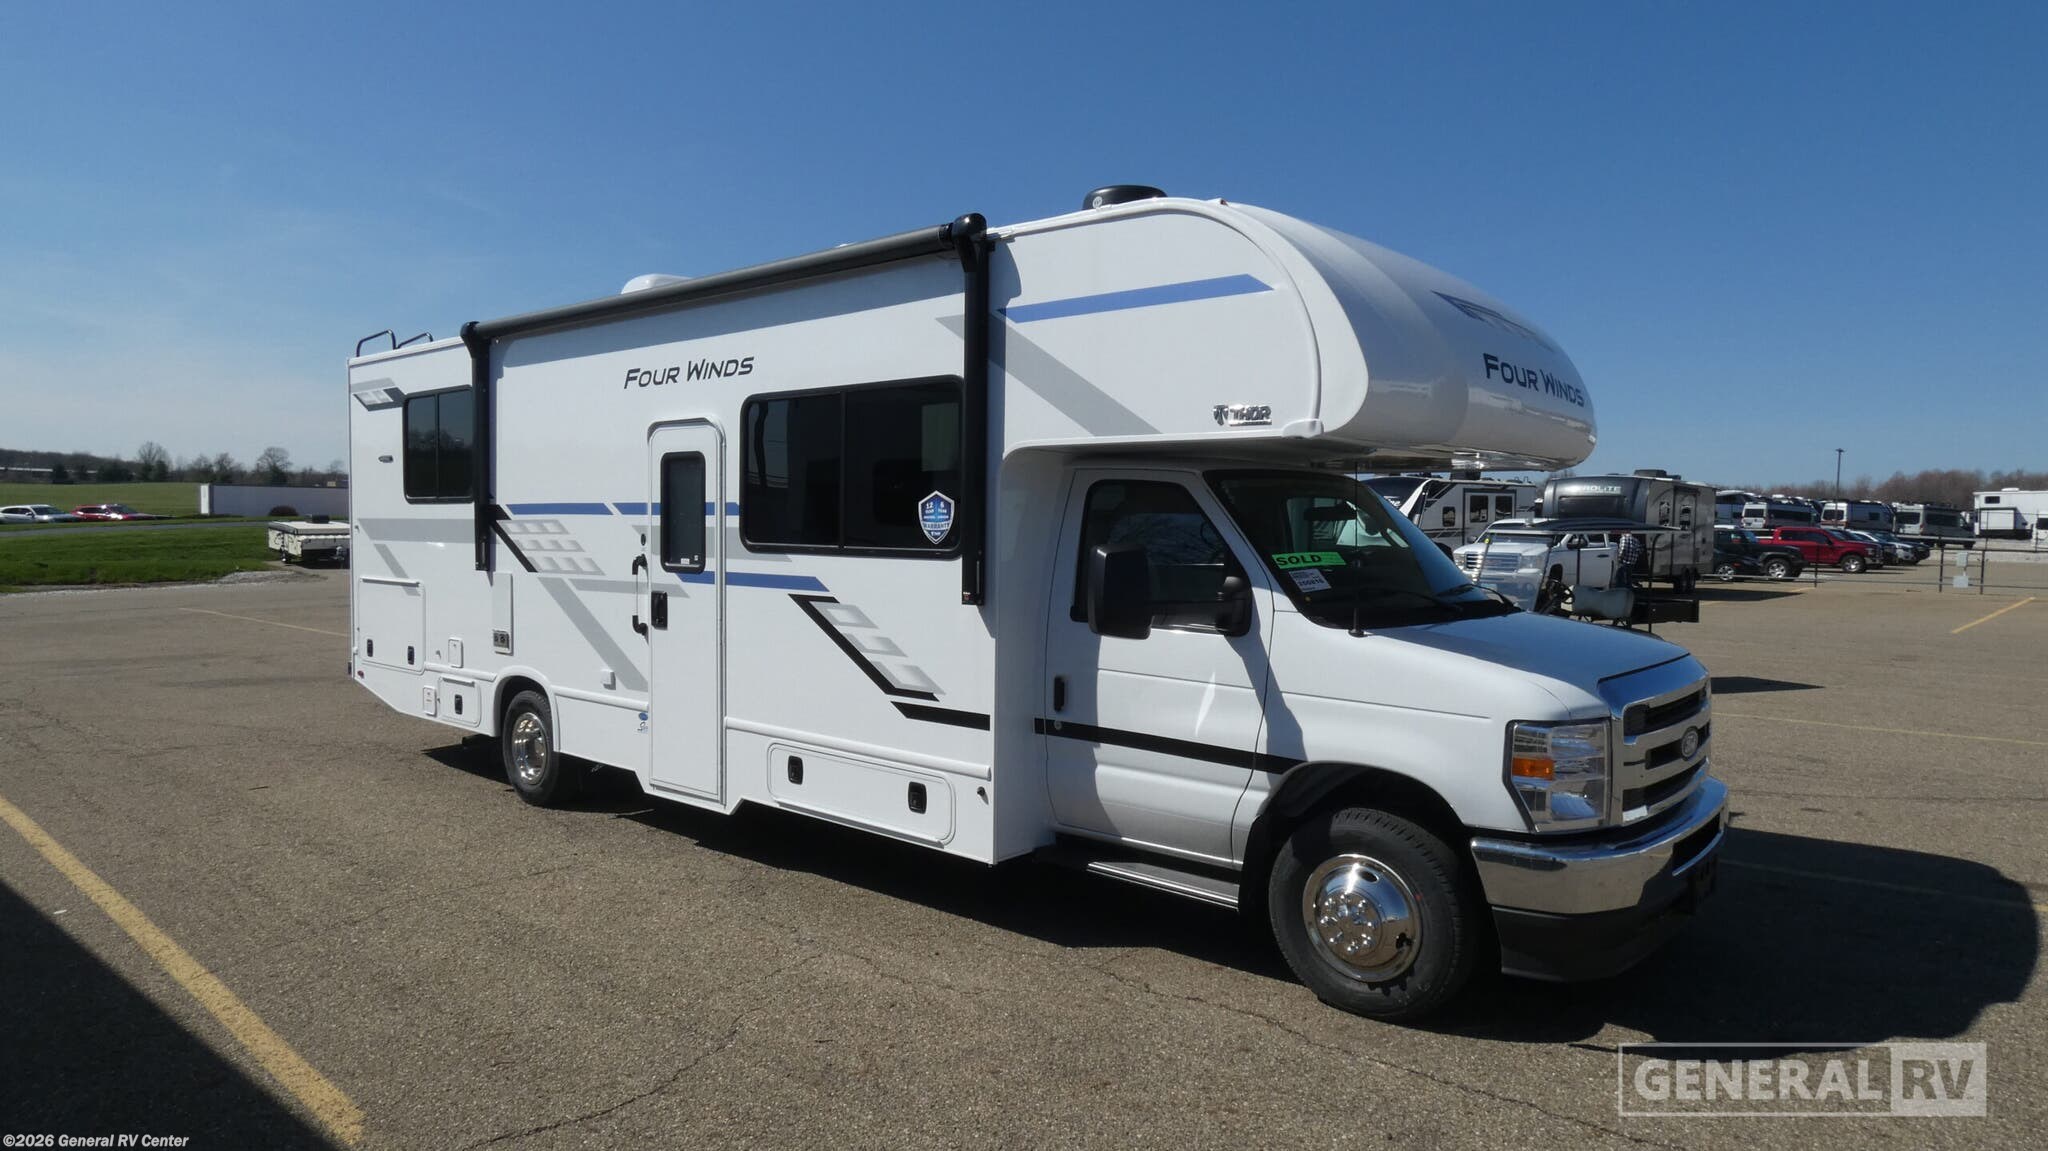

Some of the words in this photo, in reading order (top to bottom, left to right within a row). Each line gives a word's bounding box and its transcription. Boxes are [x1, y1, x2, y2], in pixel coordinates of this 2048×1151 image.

[623, 366, 681, 390] FOUR
[686, 356, 755, 382] WINDS
[1482, 352, 1540, 392] FOUR
[1539, 368, 1585, 408] WINDS
[1229, 405, 1272, 421] THOR
[1275, 554, 1322, 566] SOLD
